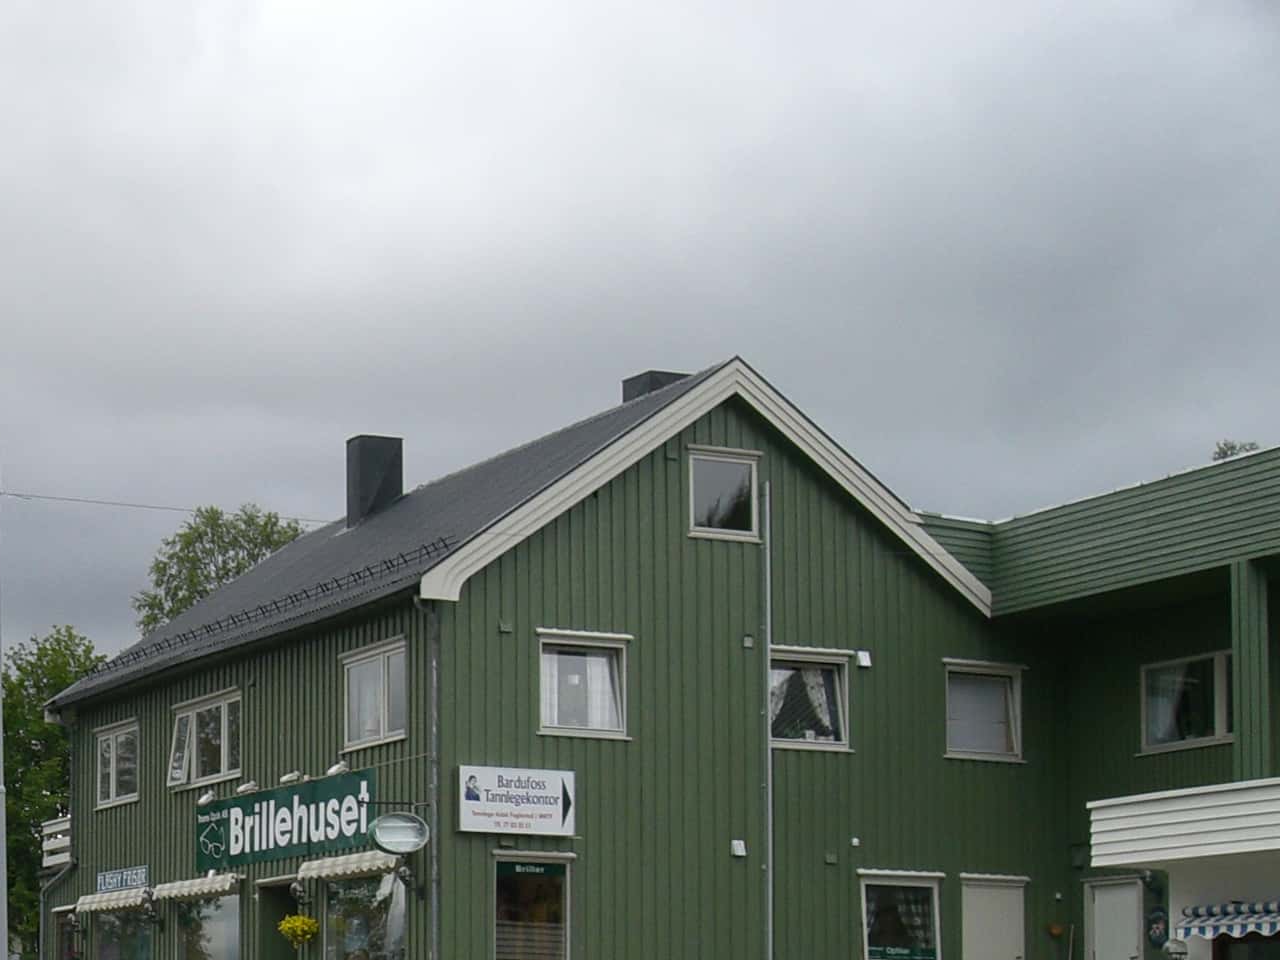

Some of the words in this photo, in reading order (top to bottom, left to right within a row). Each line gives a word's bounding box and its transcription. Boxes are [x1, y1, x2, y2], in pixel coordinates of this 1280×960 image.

[497, 774, 546, 791] Bardufoss
[483, 788, 560, 807] Tannlegekontor
[229, 780, 370, 856] Brillehuset
